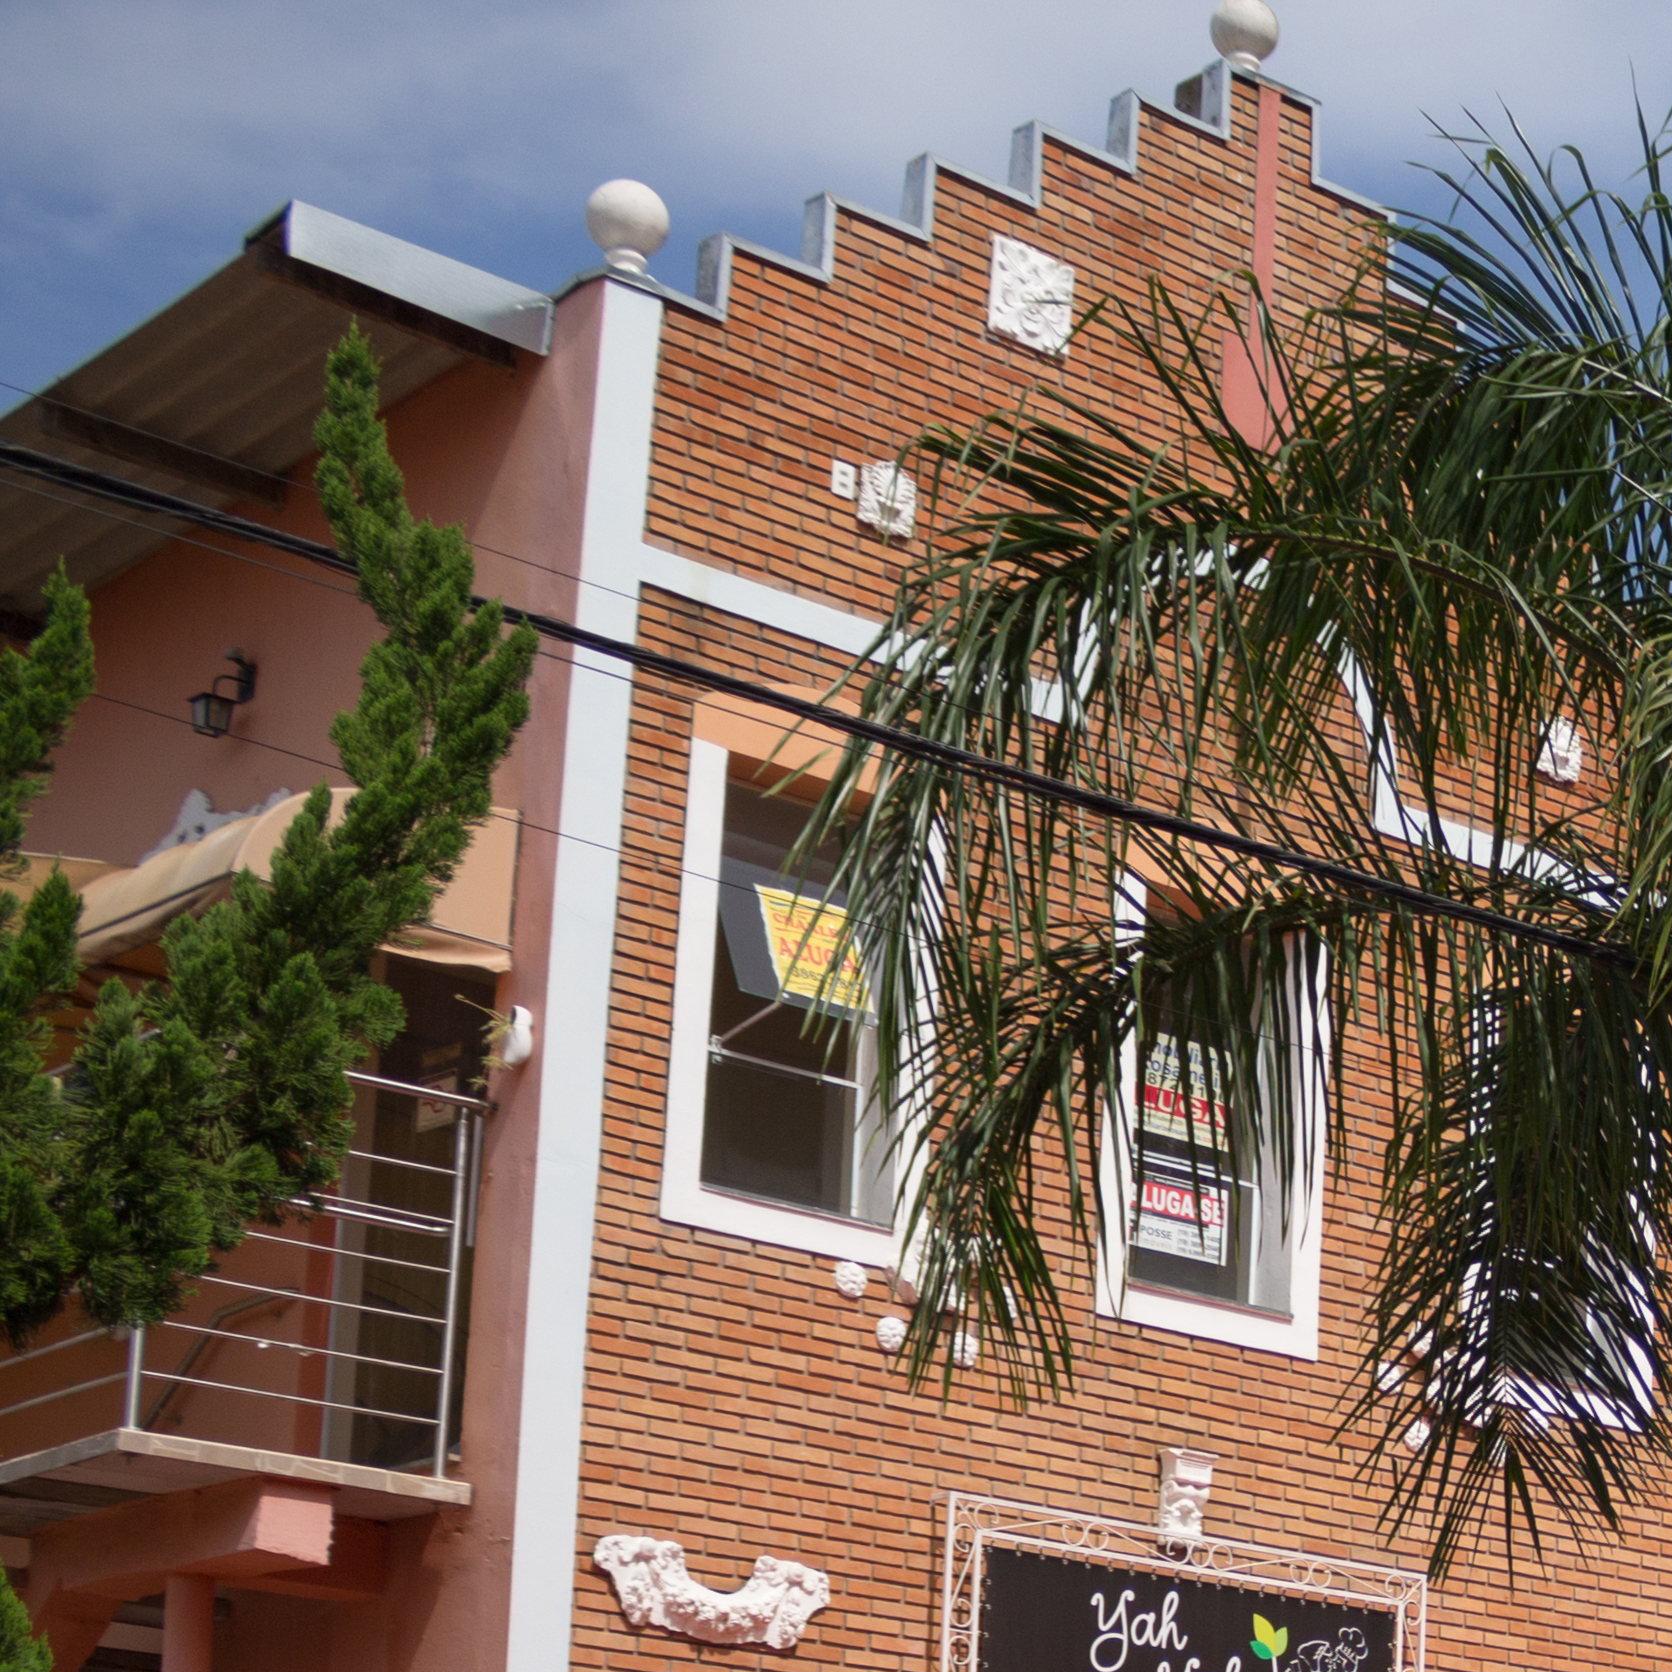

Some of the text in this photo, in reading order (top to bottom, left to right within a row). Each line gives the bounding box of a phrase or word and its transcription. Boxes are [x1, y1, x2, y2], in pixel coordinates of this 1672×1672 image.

[1130, 1182, 1225, 1225] LUGA-SE
[1140, 1223, 1173, 1240] POSSE
[1090, 1589, 1187, 1672] Yah
